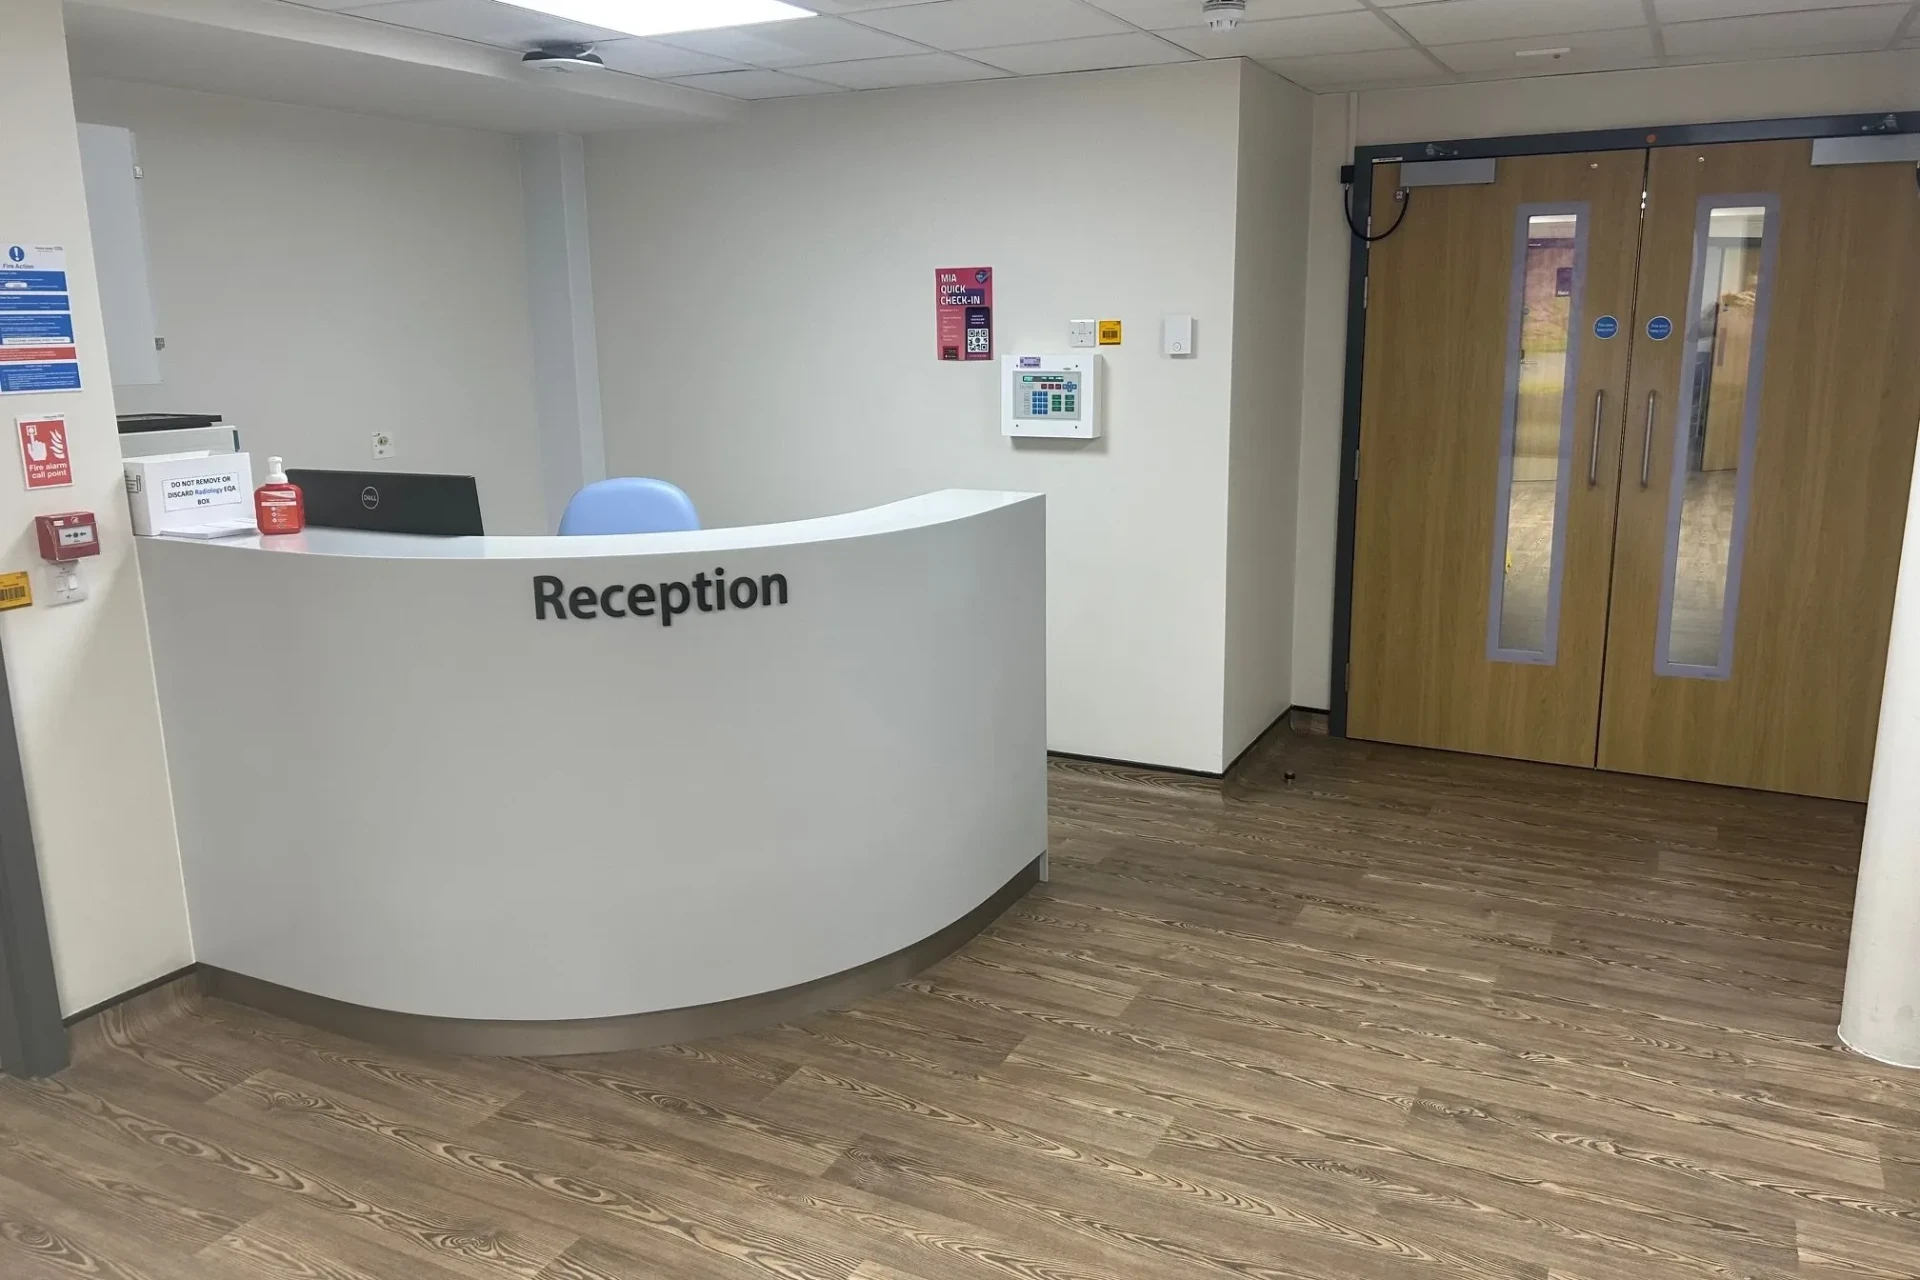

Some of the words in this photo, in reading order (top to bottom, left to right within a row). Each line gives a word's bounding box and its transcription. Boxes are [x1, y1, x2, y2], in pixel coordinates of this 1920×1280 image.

[941, 273, 957, 283] MIA
[940, 284, 966, 294] QUICK
[940, 295, 980, 305] CHECK-IN
[46, 462, 67, 470] alarm
[32, 470, 45, 478] call
[47, 469, 67, 478] point
[182, 480, 195, 488] NOT
[195, 477, 221, 486] REMOVE
[221, 475, 231, 483] OR
[167, 490, 194, 499] DISCARD
[194, 486, 223, 496] Radiology
[363, 494, 377, 502] DELL
[533, 567, 788, 627] Reception
